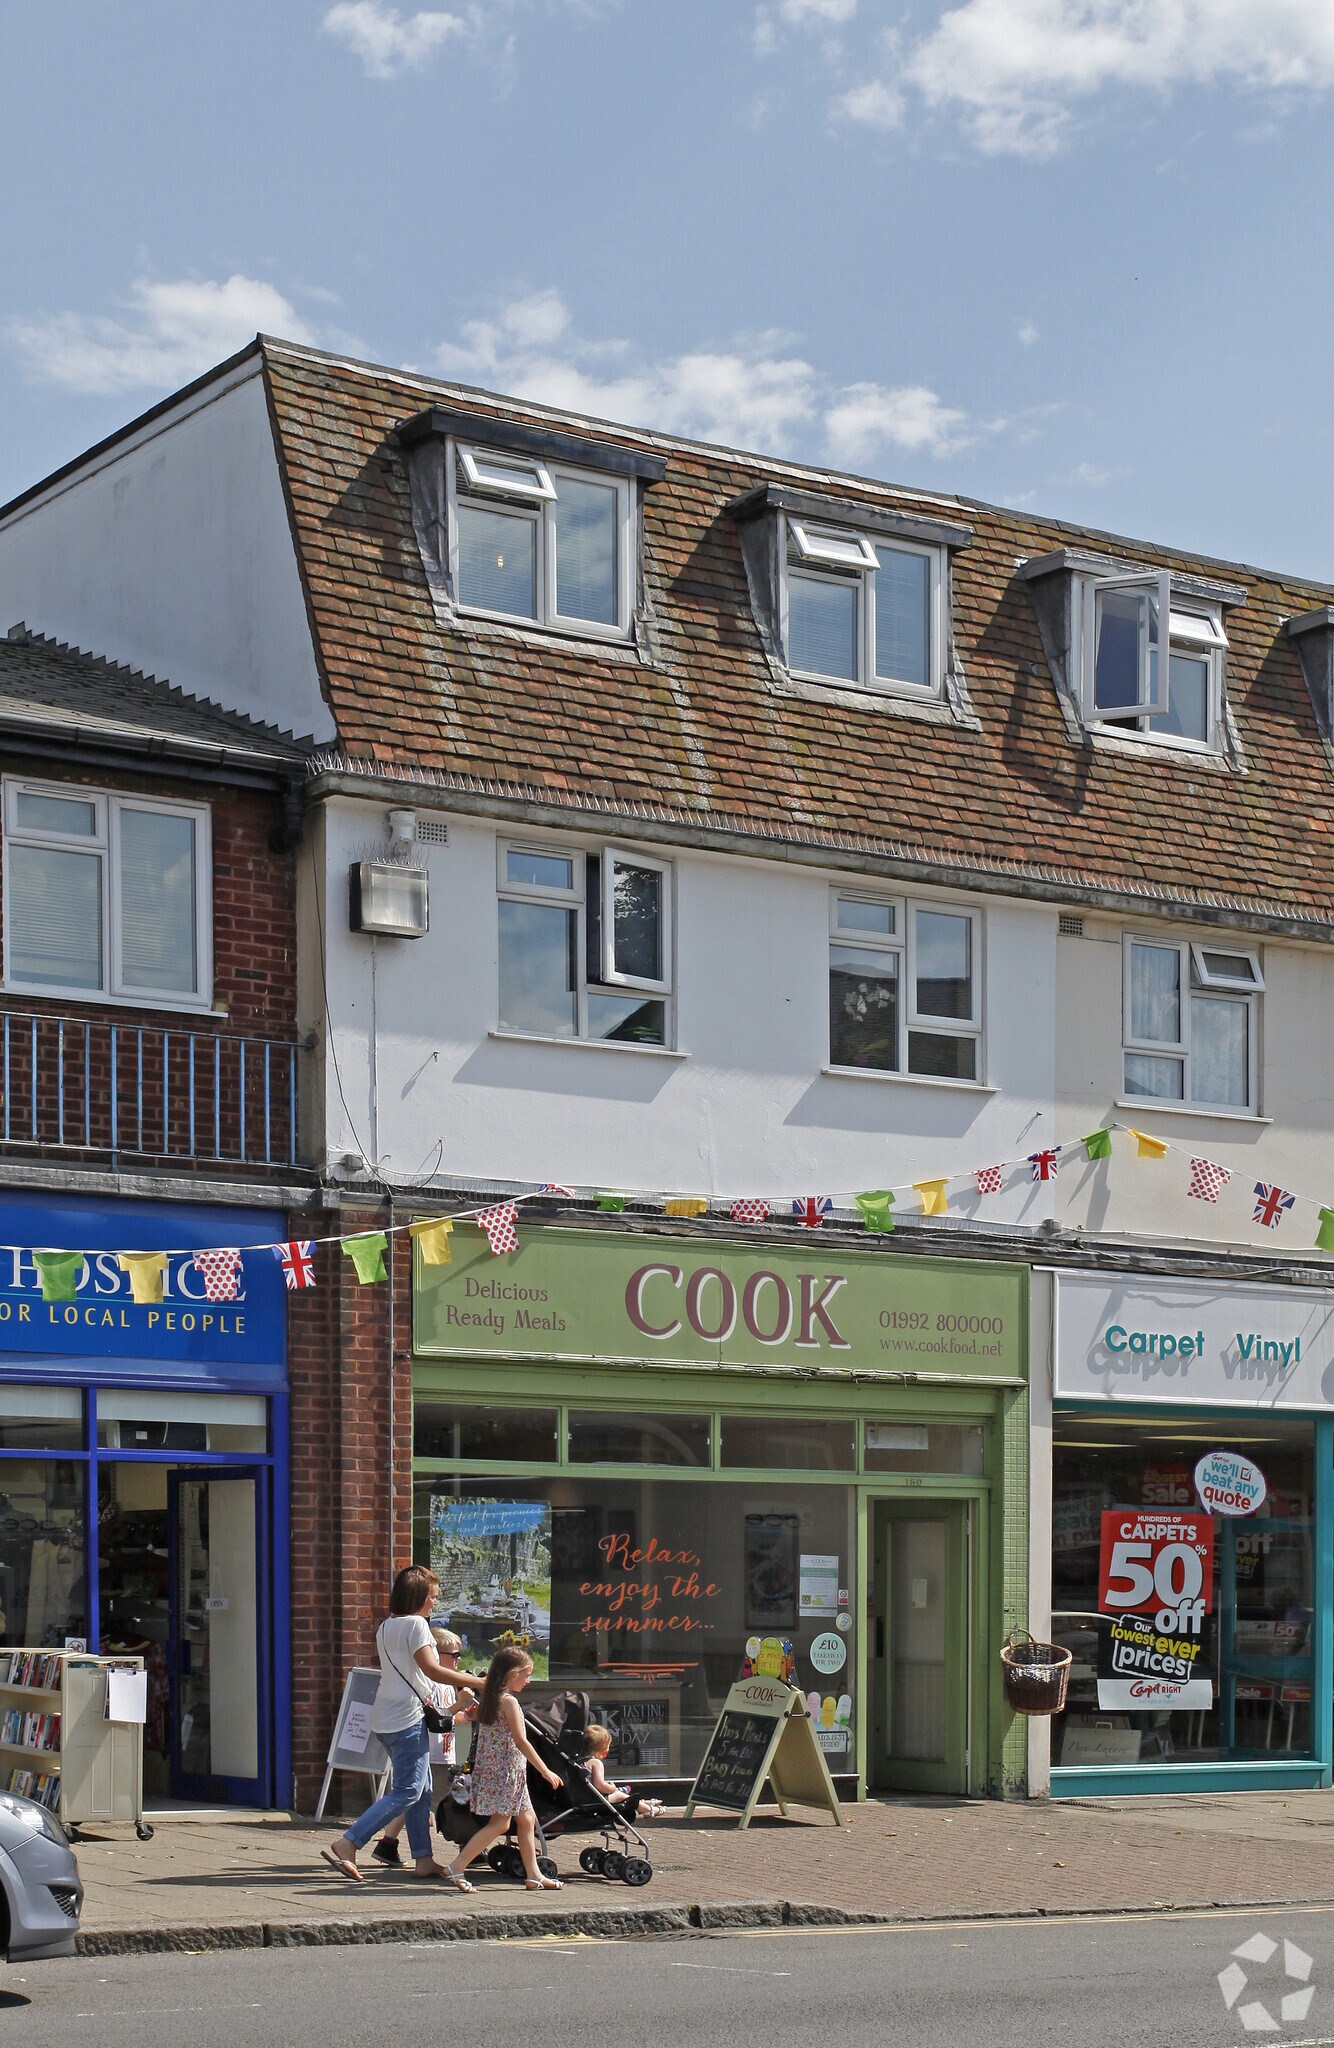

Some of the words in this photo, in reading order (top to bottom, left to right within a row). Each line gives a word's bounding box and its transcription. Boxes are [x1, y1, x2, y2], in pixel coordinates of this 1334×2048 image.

[8, 1249, 247, 1301] HSIC
[464, 1277, 548, 1302] Delicious
[624, 1262, 851, 1349] COOK
[49, 1306, 130, 1328] LOCAL
[148, 1311, 245, 1334] PEOPLE
[446, 1304, 505, 1335] Ready
[514, 1308, 566, 1332] Meals
[879, 1310, 929, 1330] 01992
[936, 1314, 1004, 1335] 800000
[879, 1337, 1003, 1356] www.cookfood.net
[1105, 1324, 1205, 1361] Carpet
[1236, 1333, 1301, 1368] Vinyl
[1211, 1461, 1238, 1478] we'll
[1142, 1482, 1189, 1503] Sale
[1202, 1468, 1232, 1489] beat
[1234, 1481, 1259, 1498] any
[1203, 1486, 1251, 1510] quote
[481, 1510, 496, 1521] for
[456, 1525, 477, 1533] and
[1120, 1522, 1197, 1541] CARPETS
[598, 1534, 700, 1570] Relax,
[579, 1581, 662, 1611] enjoy
[664, 1572, 722, 1598] the
[579, 1616, 715, 1632] summer...
[1155, 1598, 1206, 1634] off
[819, 1640, 838, 1650] £10
[1110, 1624, 1155, 1647] lowest
[1156, 1636, 1200, 1661] ever
[1118, 1645, 1187, 1677] prices
[746, 1686, 777, 1702] COOK
[621, 1704, 664, 1718] TASTING
[622, 1732, 650, 1744] DAY
